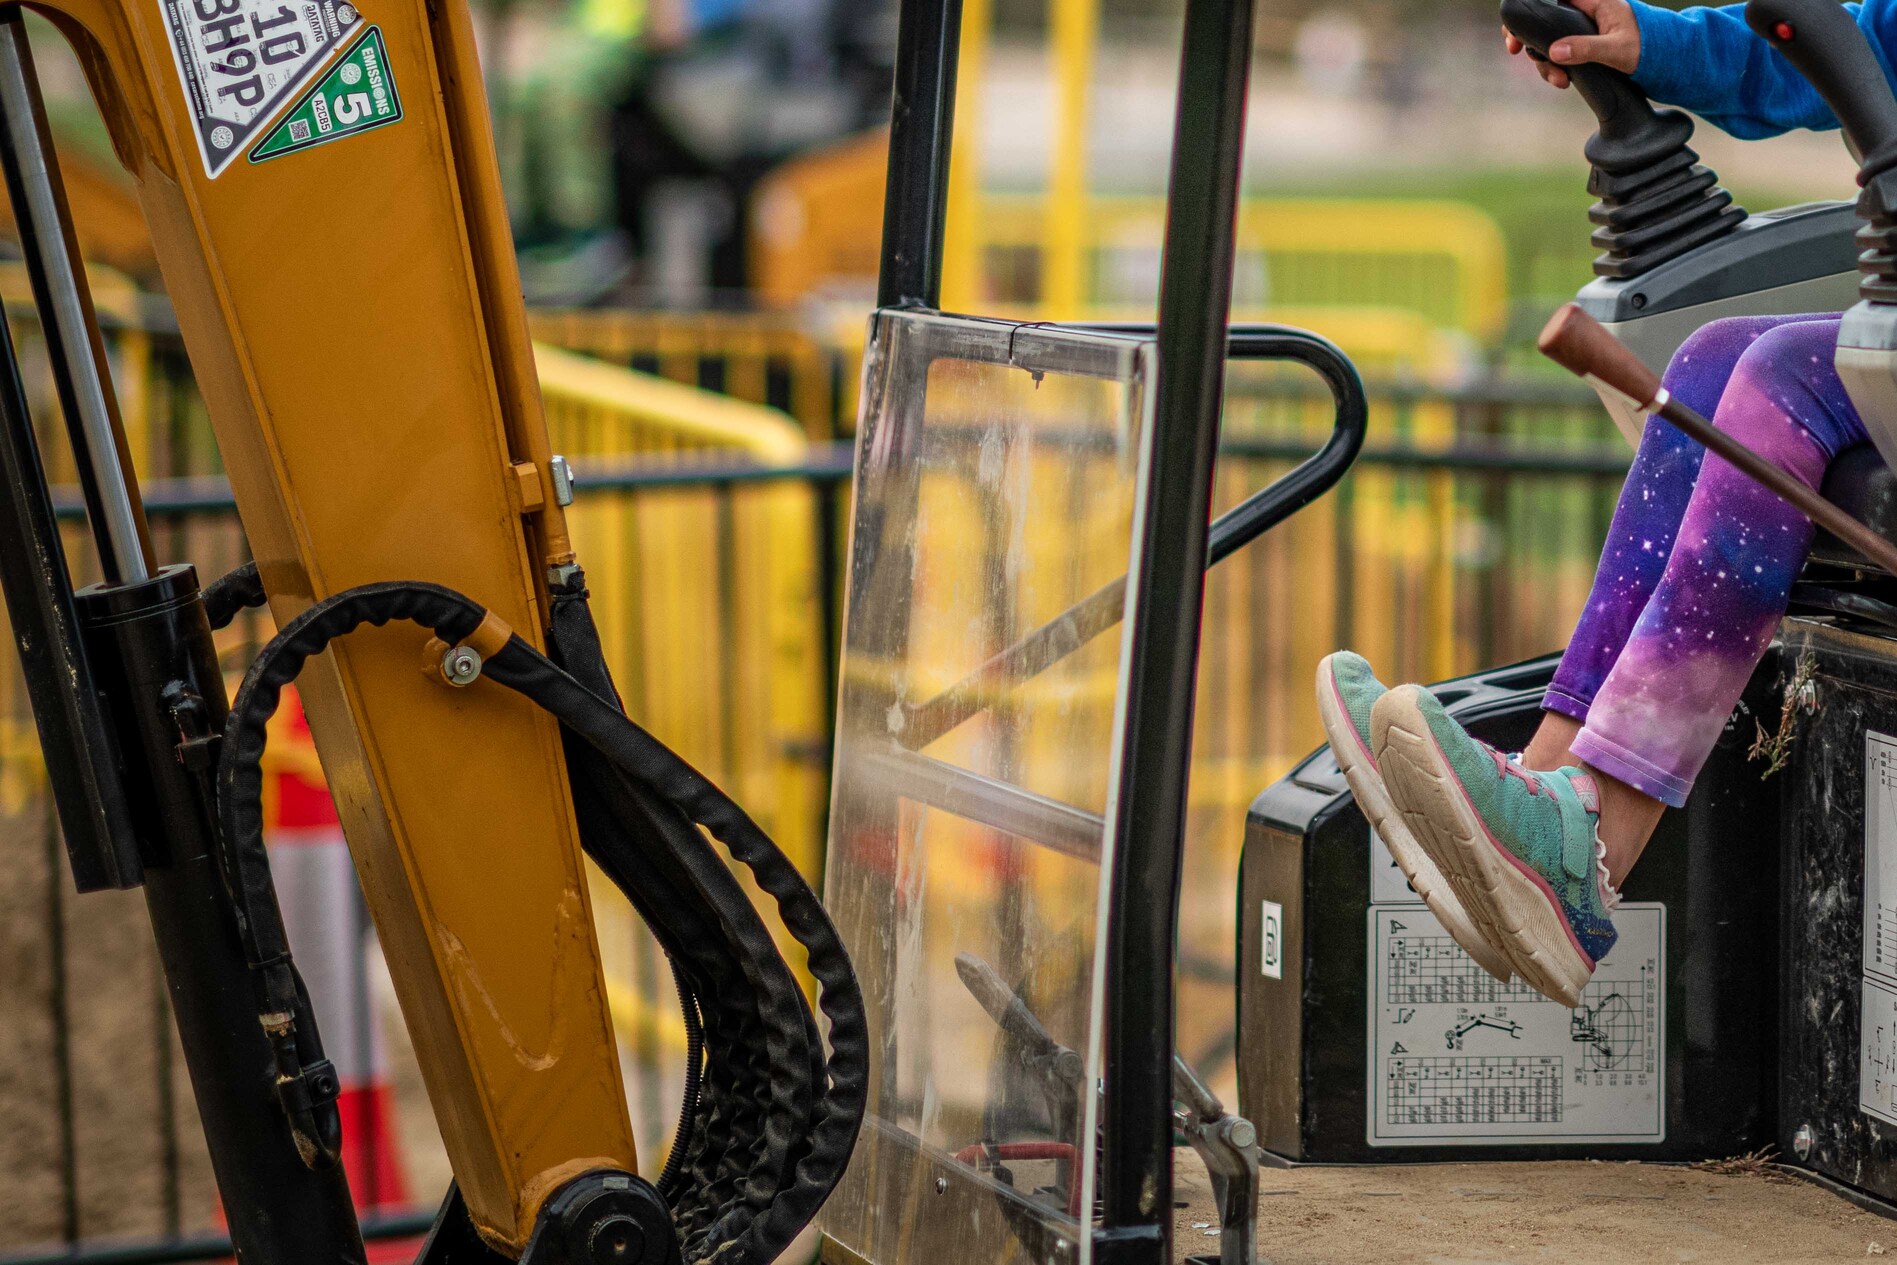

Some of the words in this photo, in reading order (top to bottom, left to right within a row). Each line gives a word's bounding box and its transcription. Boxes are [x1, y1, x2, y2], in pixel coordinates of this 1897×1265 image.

[250, 5, 306, 65] 10
[307, 4, 324, 42] DATATAG
[324, 0, 341, 37] WARNING
[361, 47, 390, 115] EMISSIONS
[314, 100, 331, 131] A2CB5
[333, 92, 373, 125] 5
